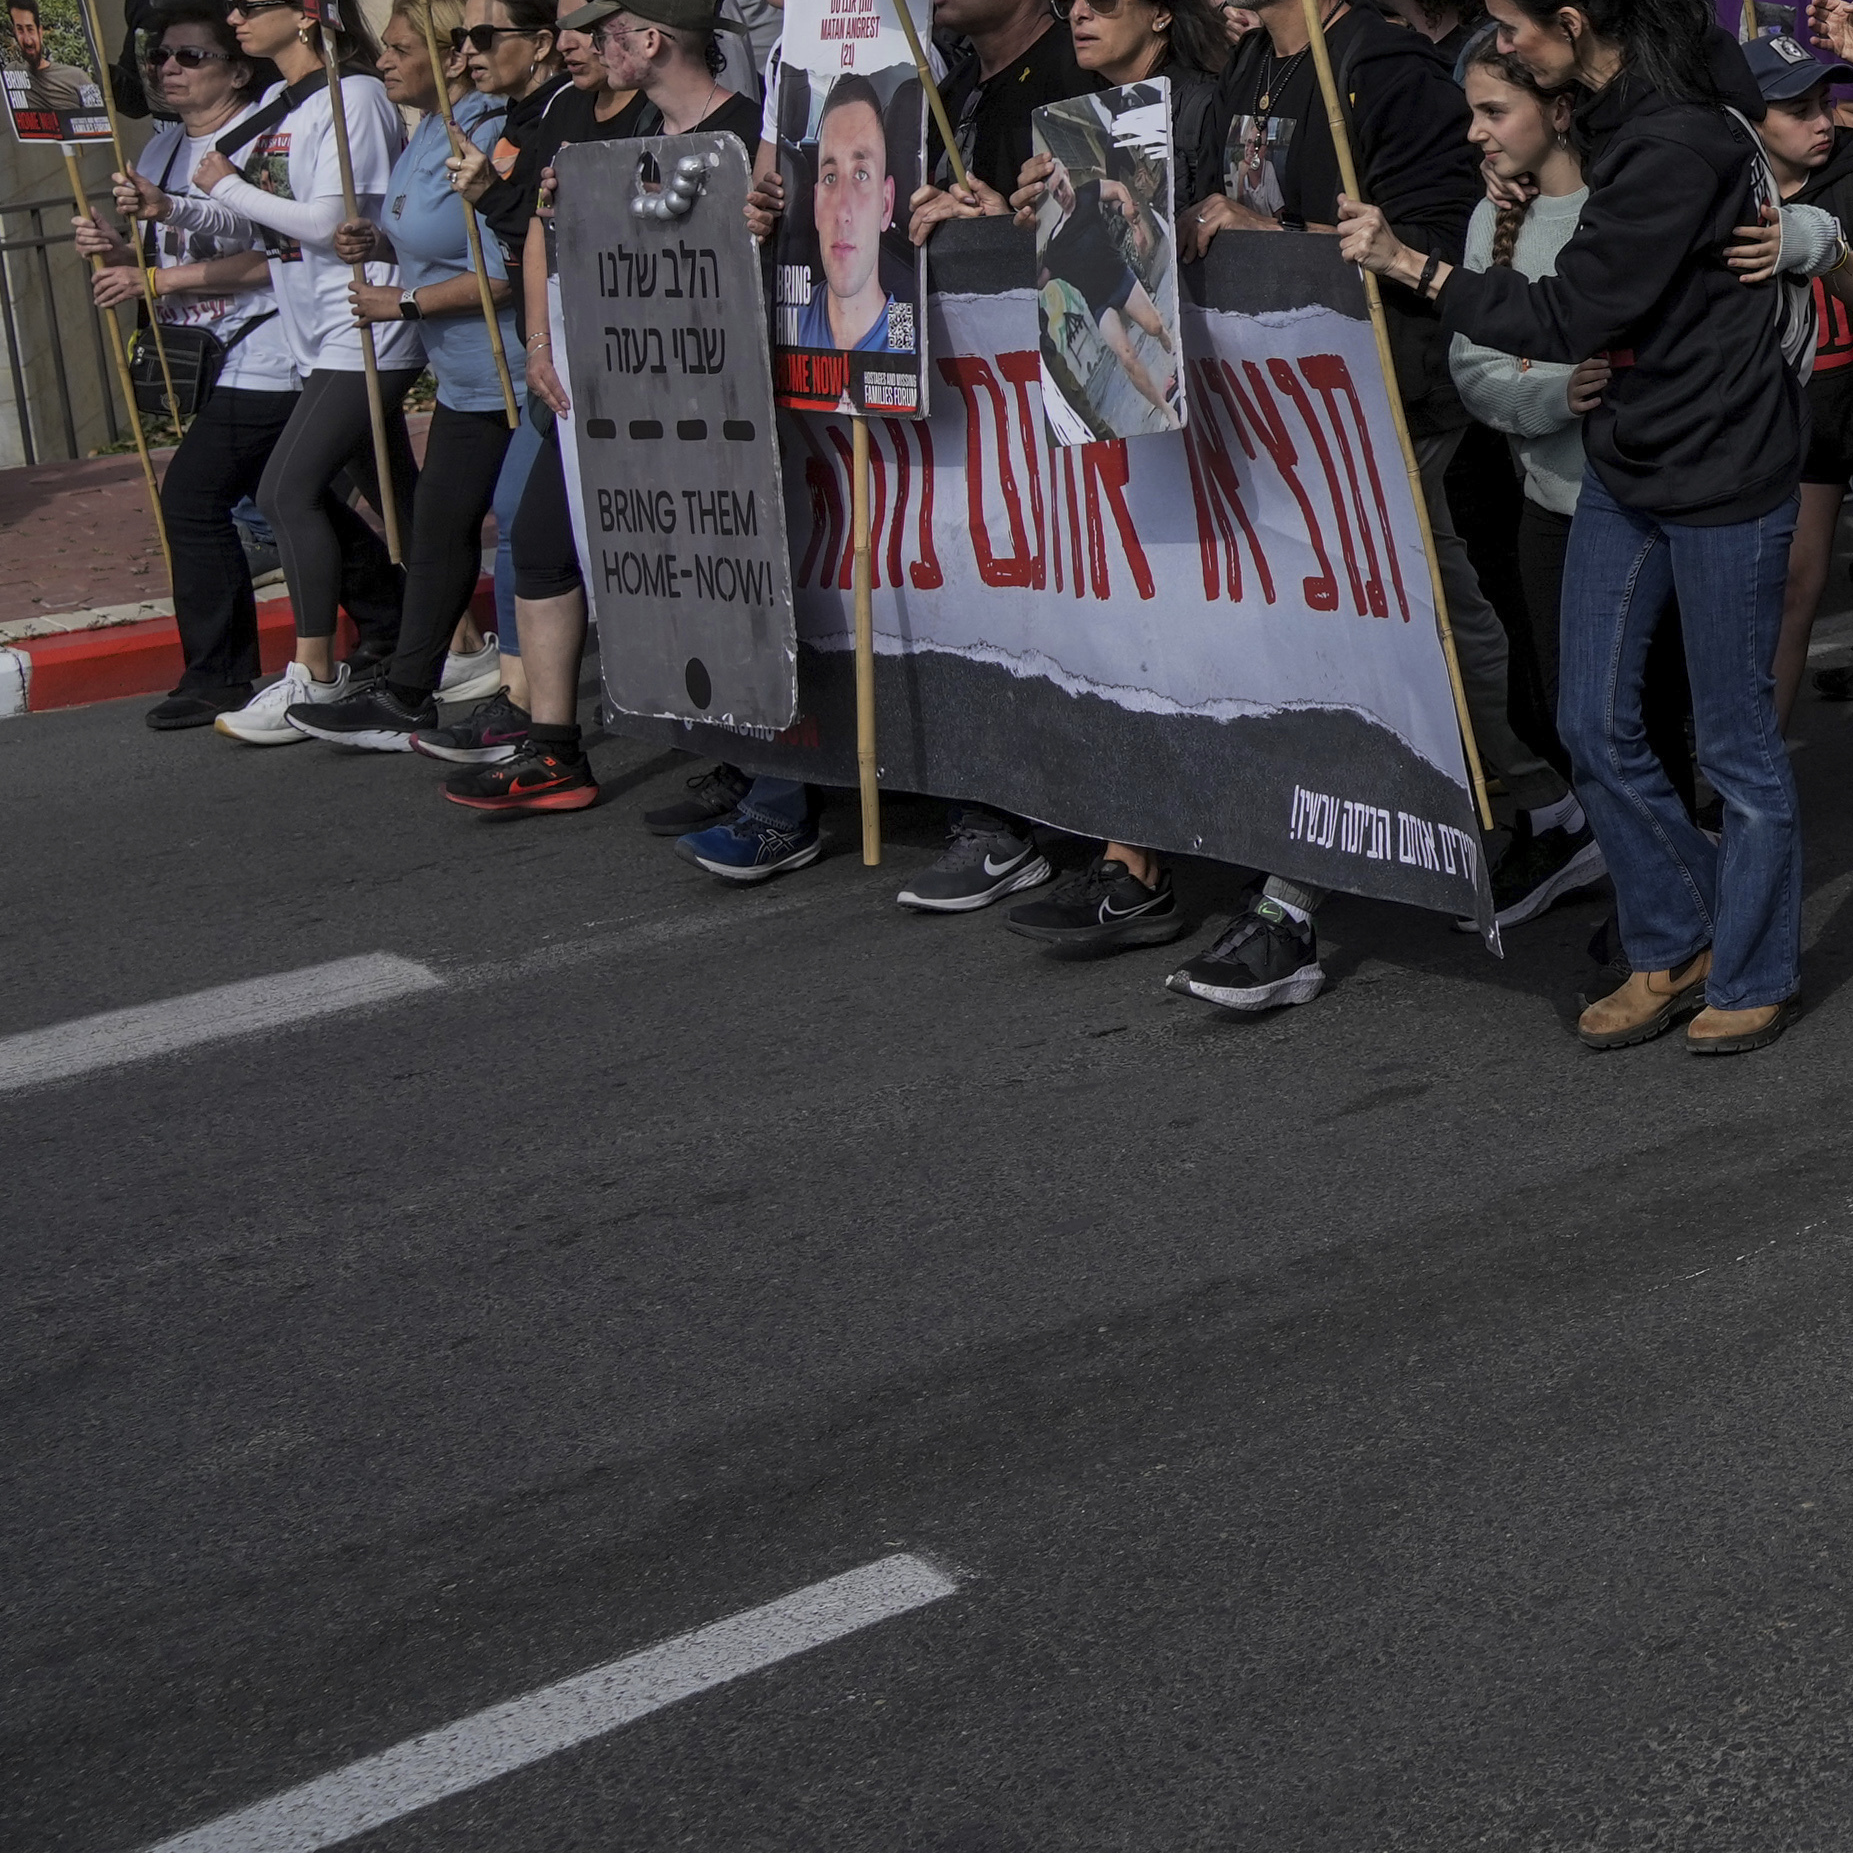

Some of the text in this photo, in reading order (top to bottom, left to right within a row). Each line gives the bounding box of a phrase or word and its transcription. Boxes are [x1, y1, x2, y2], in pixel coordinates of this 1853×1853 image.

[820, 16, 880, 40] MATAN ANGREST
[598, 240, 720, 299] הלב שלנו
[604, 324, 726, 376] שבוי בעזה
[597, 487, 758, 539] BRING THEM
[604, 549, 774, 607] HOME-NOW!
[1290, 784, 1440, 871] אותם הביתה עכשיו!
